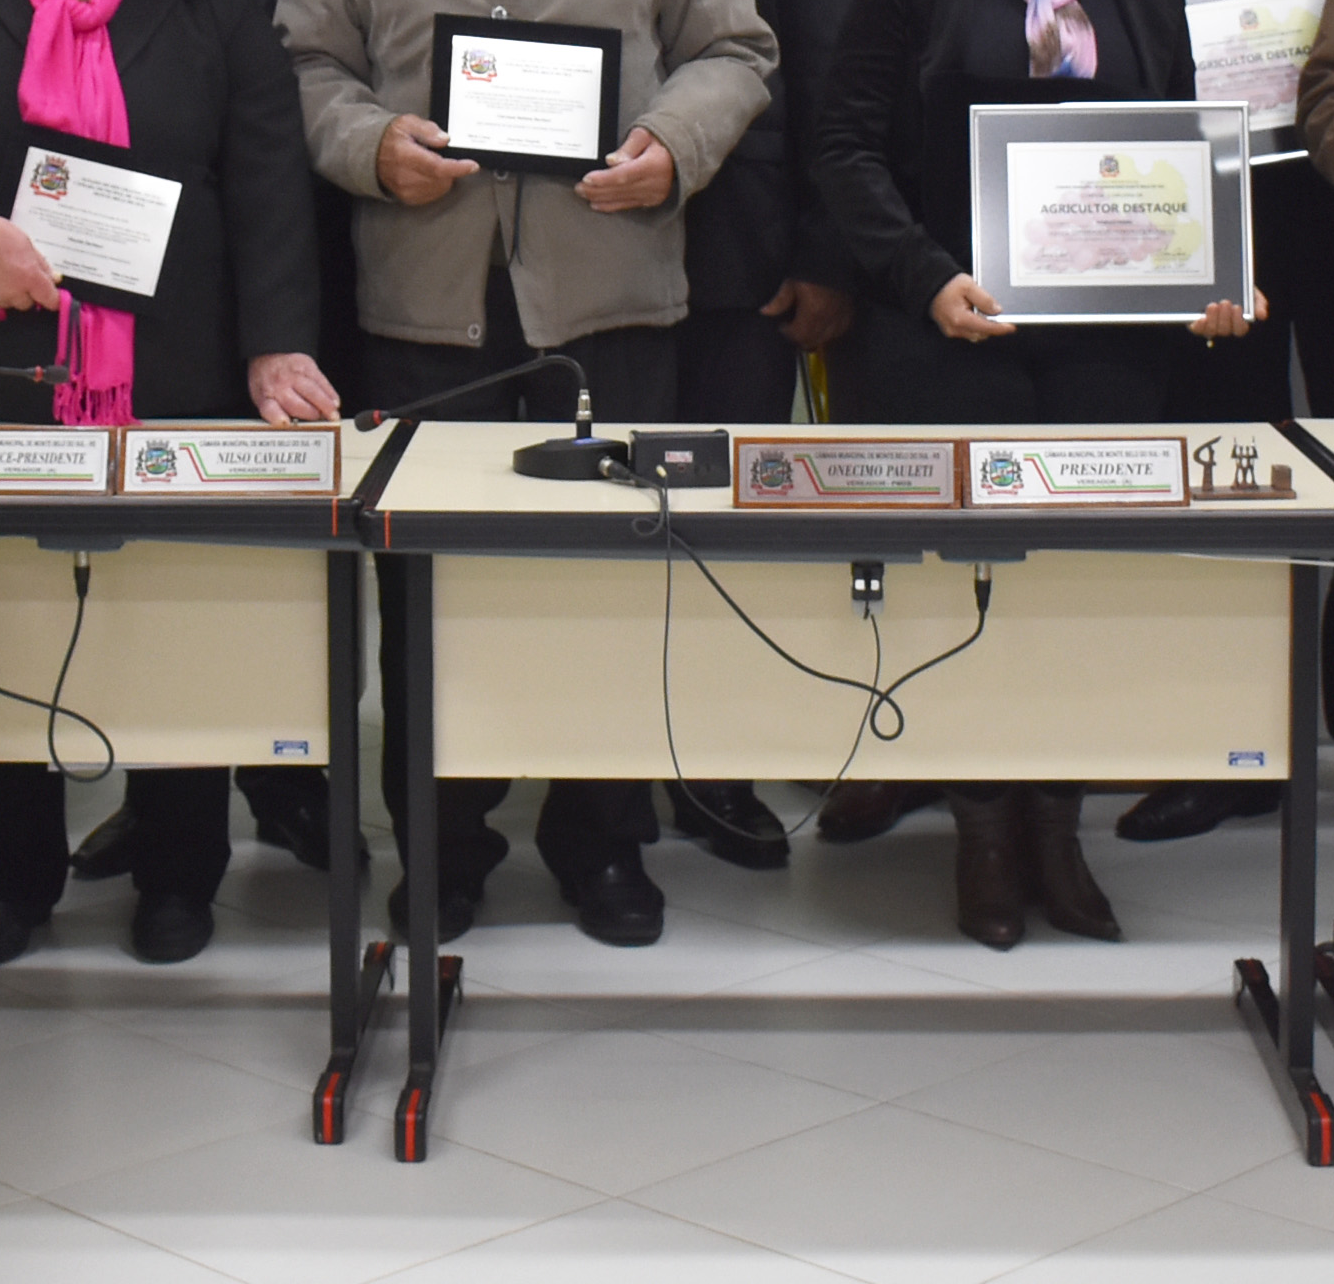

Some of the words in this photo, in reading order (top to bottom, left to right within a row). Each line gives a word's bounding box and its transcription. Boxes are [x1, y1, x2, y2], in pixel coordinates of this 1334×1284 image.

[1041, 203, 1119, 214] AGRICULTOR
[1123, 202, 1188, 215] DESTAQUE
[217, 452, 251, 464] NILSO
[254, 451, 307, 464] CAVALERI
[828, 464, 883, 477] ONECIMO
[886, 464, 933, 477] PAULETI
[1060, 462, 1154, 476] PRESIDENTE
